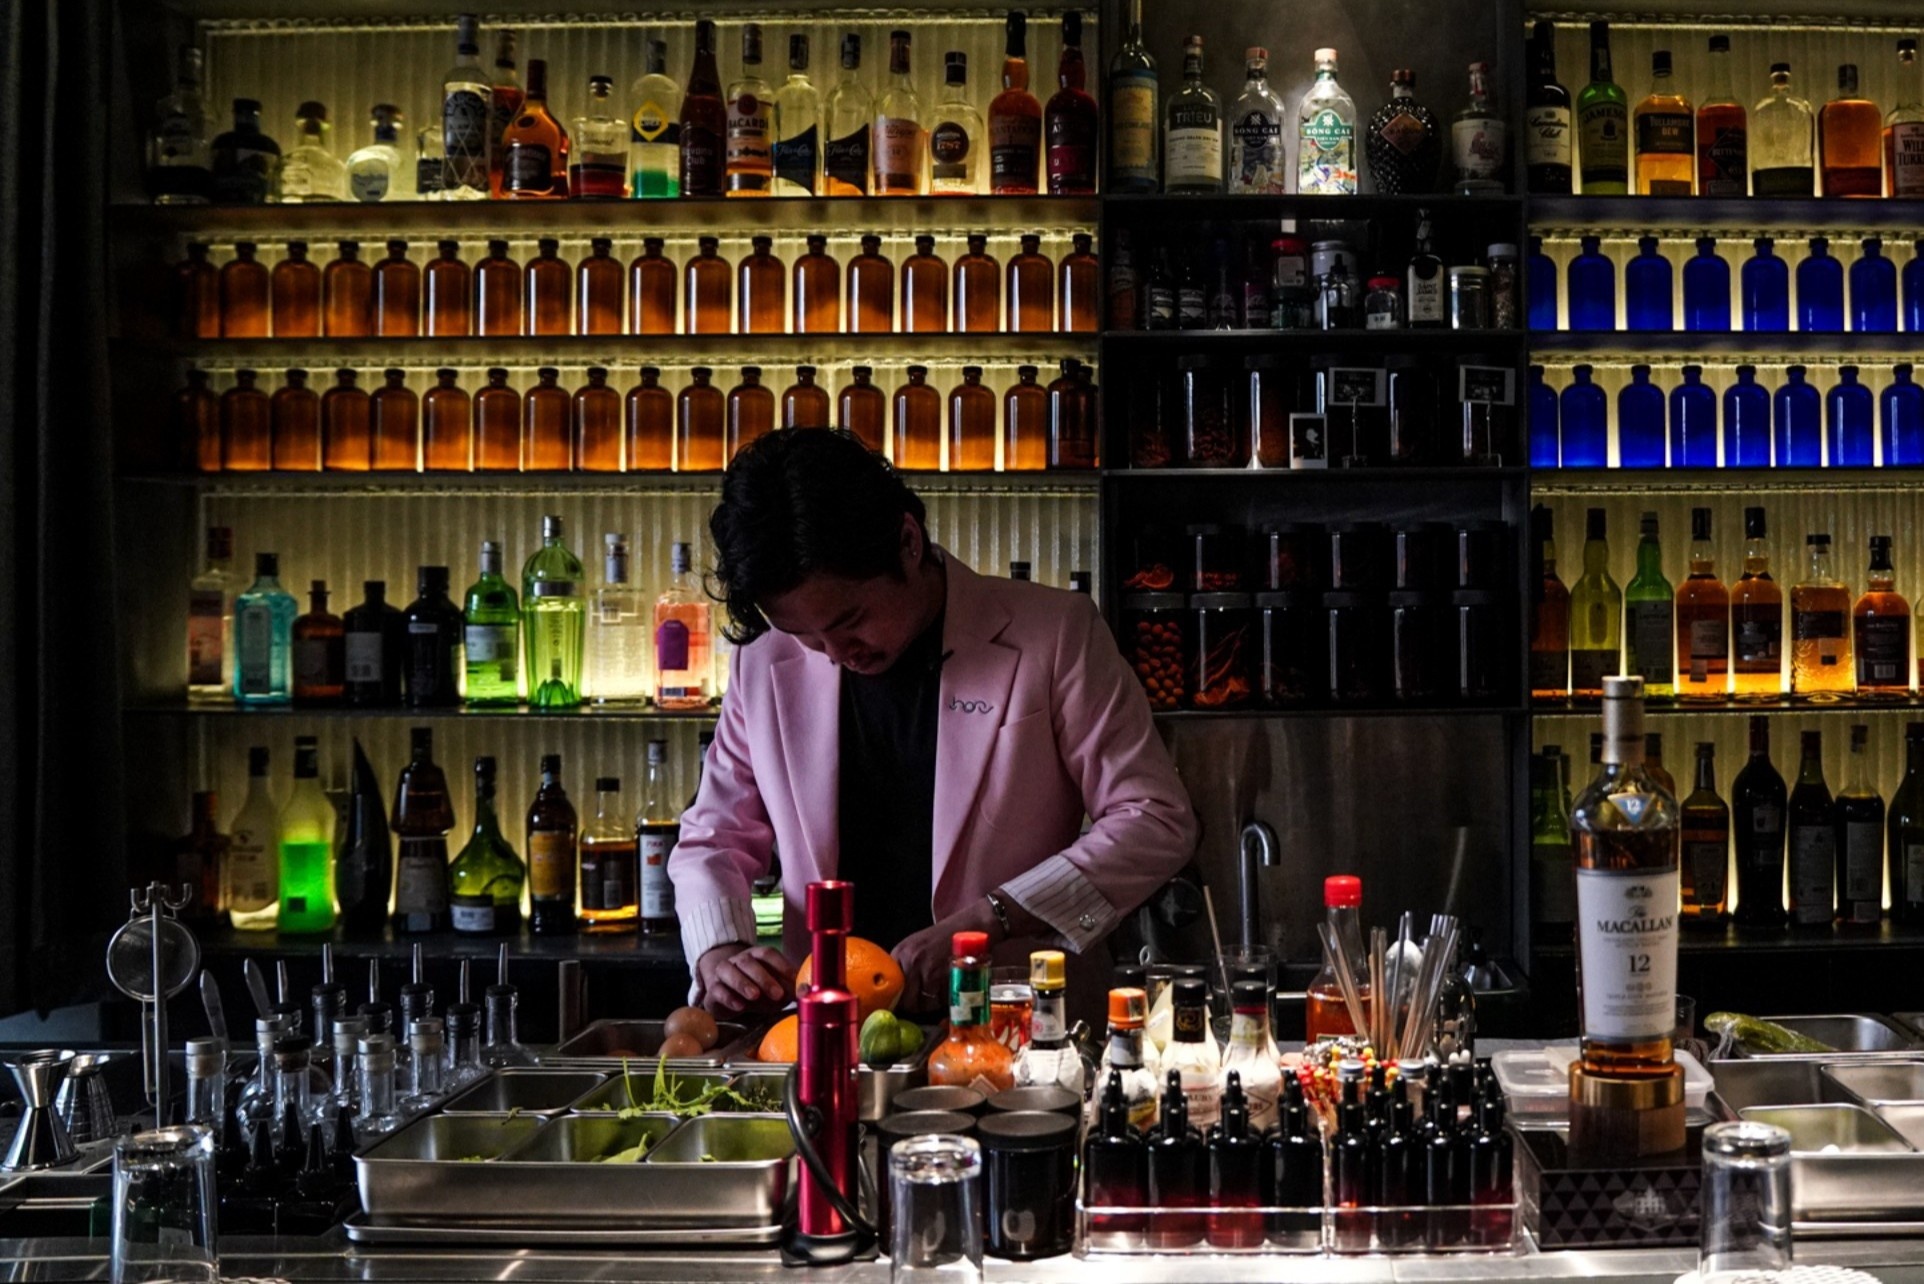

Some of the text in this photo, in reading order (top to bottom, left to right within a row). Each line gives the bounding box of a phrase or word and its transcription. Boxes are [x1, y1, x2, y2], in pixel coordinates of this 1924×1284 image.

[1896, 152, 1924, 166] TURK
[1597, 916, 1673, 934] MACALLAN
[1628, 953, 1651, 973] 12
